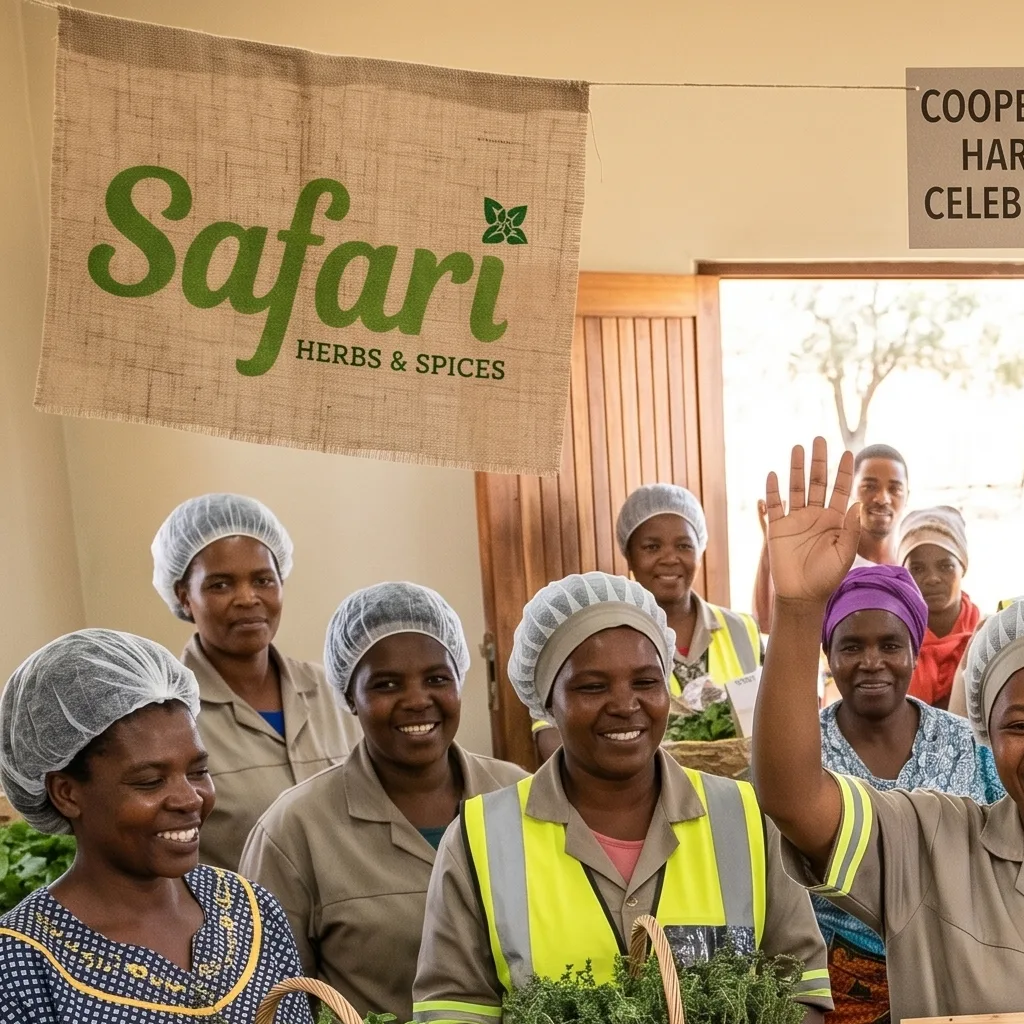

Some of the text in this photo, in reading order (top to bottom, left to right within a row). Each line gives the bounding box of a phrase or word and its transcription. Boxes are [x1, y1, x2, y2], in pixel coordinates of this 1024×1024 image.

[88, 165, 508, 377] Safari
[296, 339, 505, 380] HERBS & SPICES
